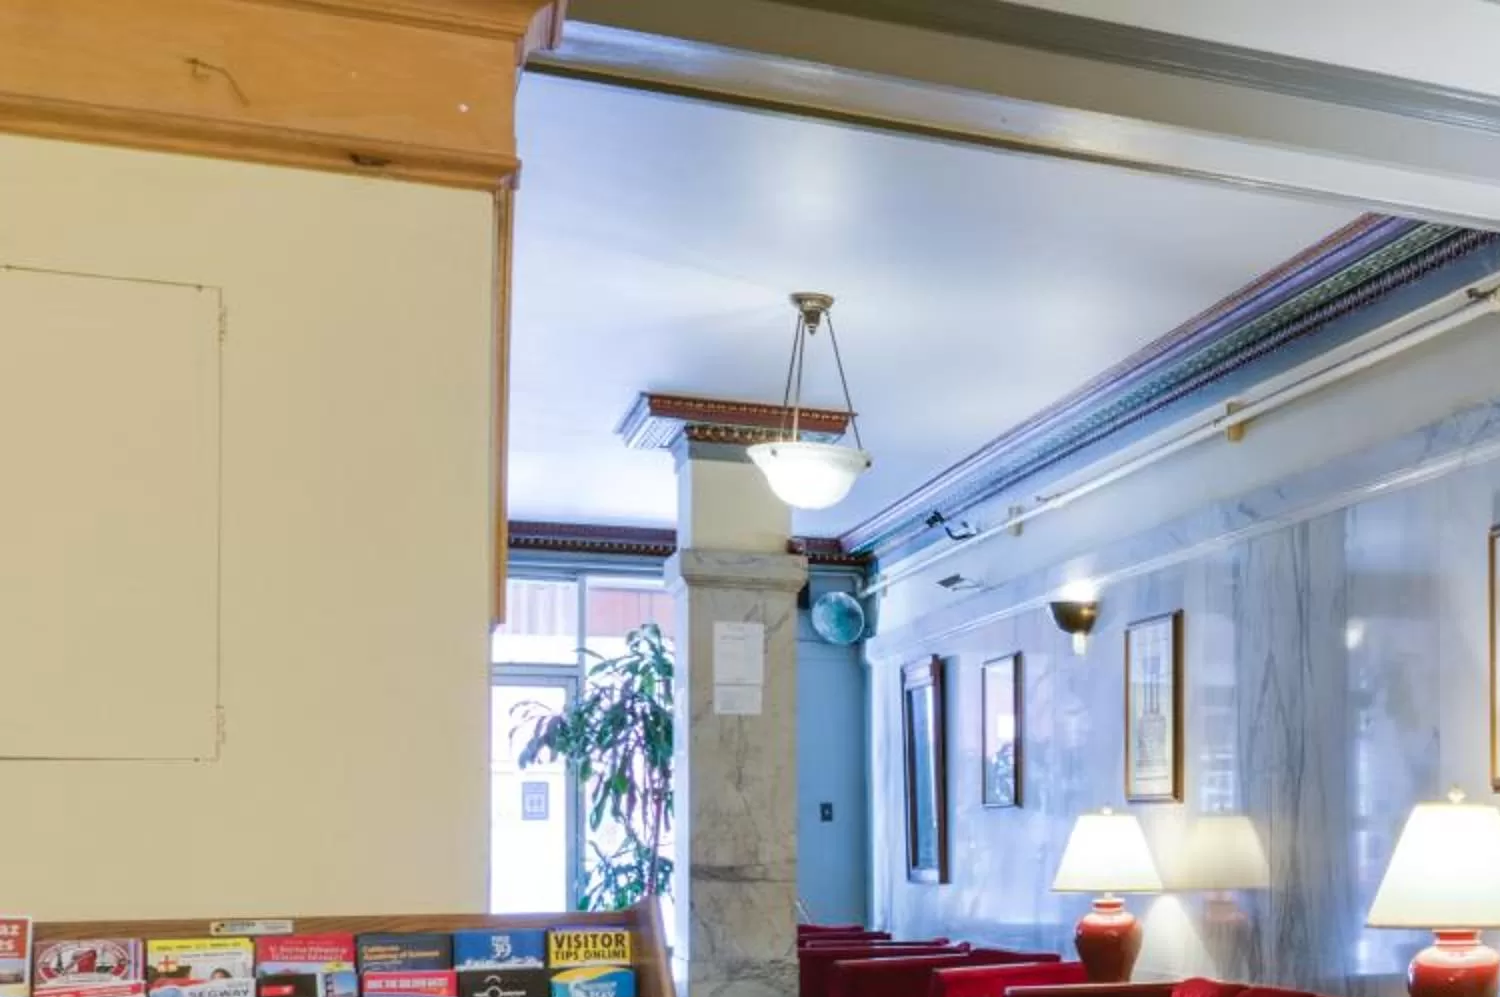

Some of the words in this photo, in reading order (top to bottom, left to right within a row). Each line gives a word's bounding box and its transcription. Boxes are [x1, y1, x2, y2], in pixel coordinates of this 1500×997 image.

[554, 933, 626, 949] VISITOR
[555, 949, 579, 960] TIPS
[583, 948, 626, 960] ONLINE
